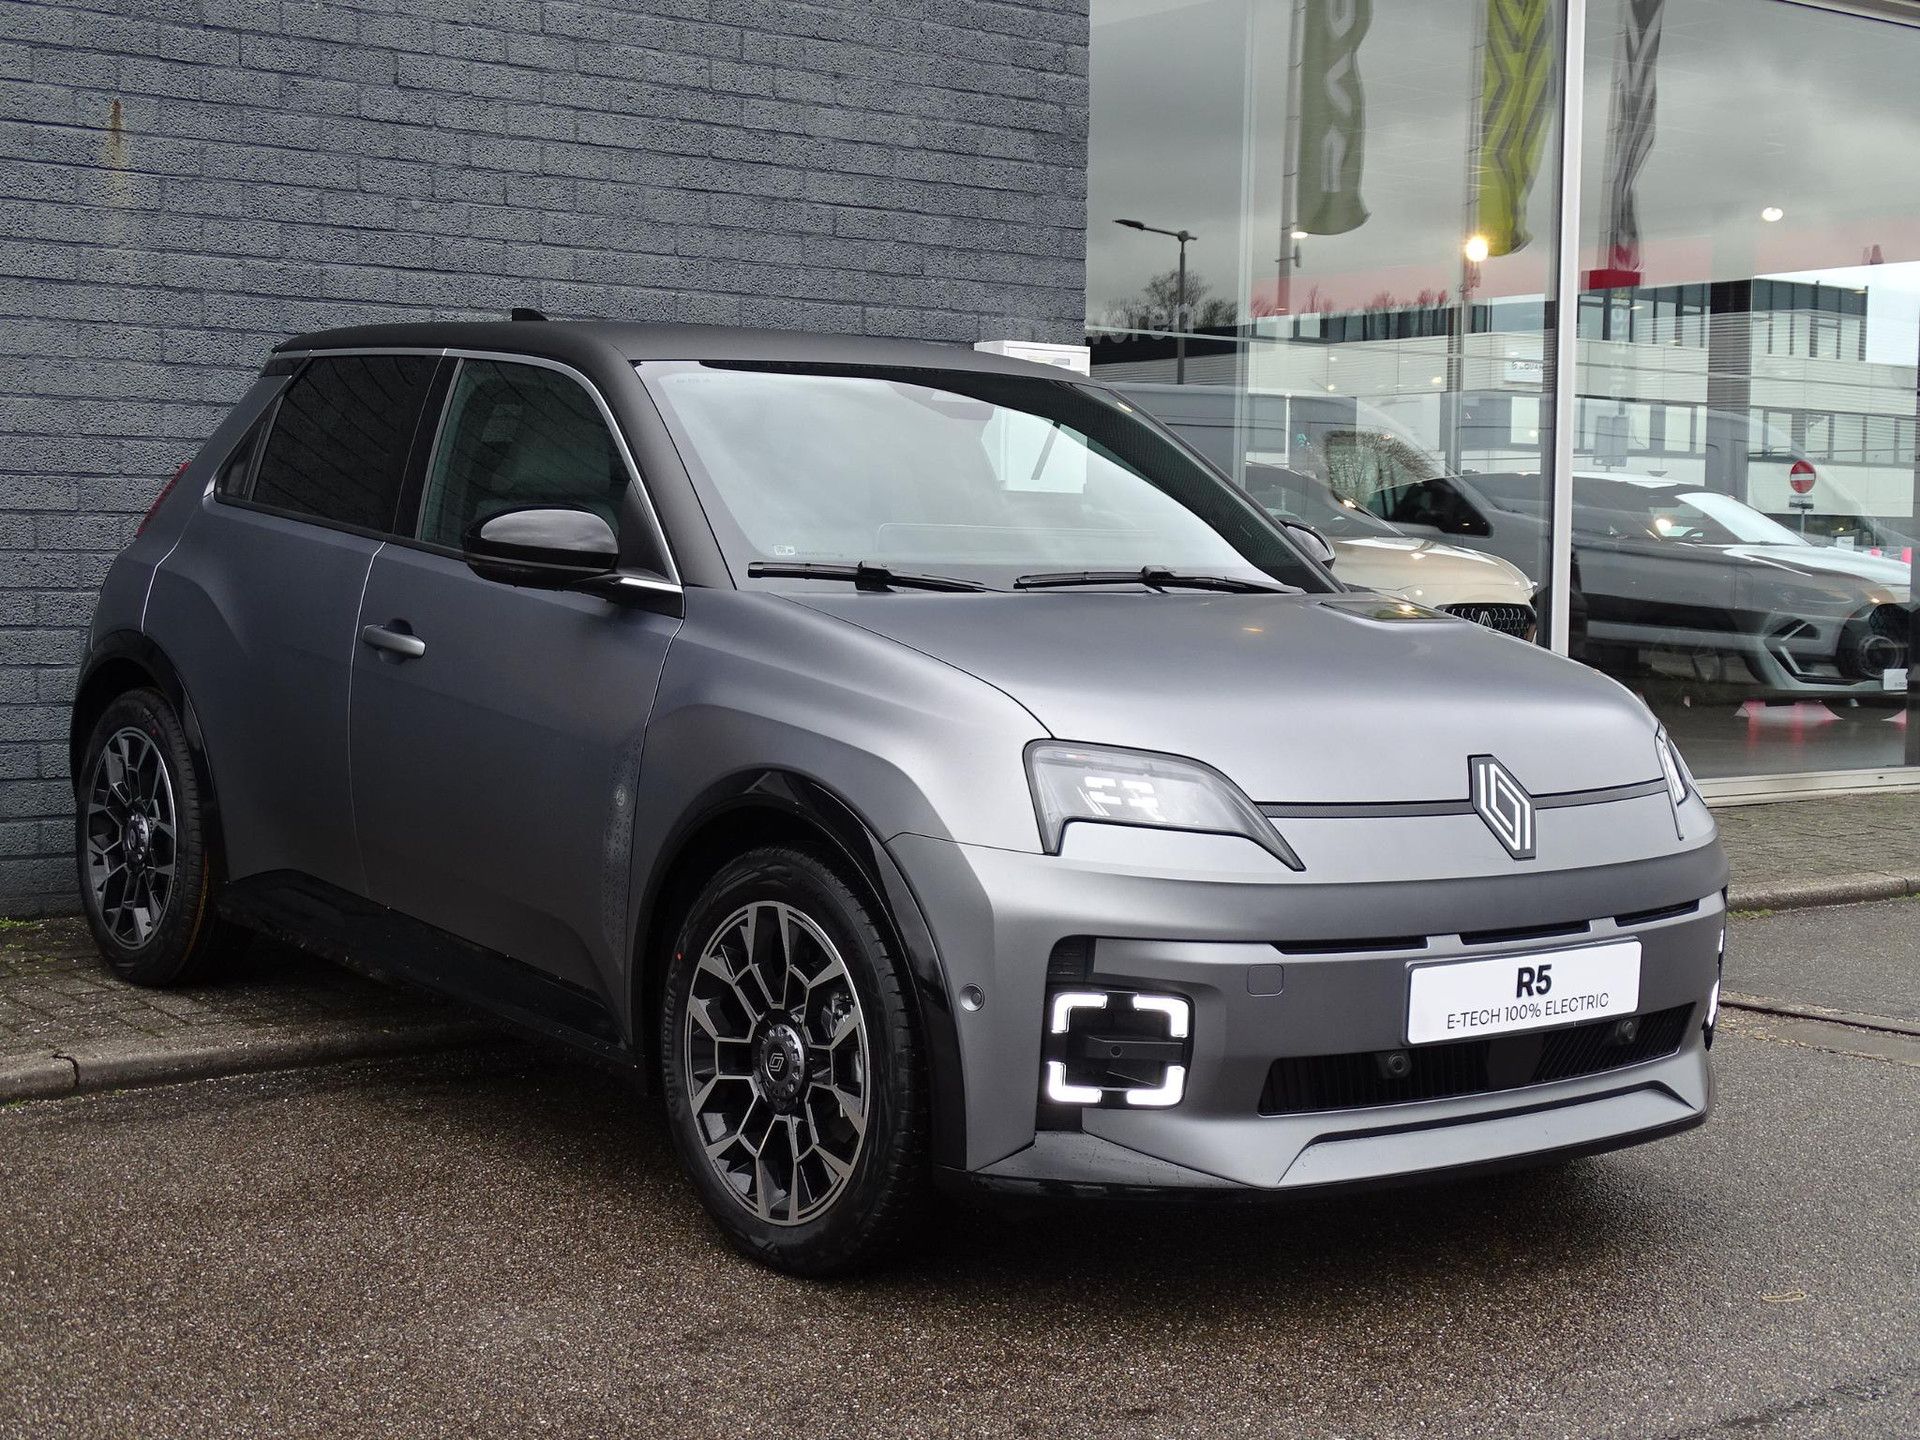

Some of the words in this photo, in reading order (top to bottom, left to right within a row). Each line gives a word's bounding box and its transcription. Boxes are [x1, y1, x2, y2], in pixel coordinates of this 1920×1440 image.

[1516, 964, 1552, 998] R5
[1447, 1008, 1501, 1030] E-TECH
[1505, 1003, 1541, 1022] 100%
[1545, 992, 1609, 1016] ELECTRIC
